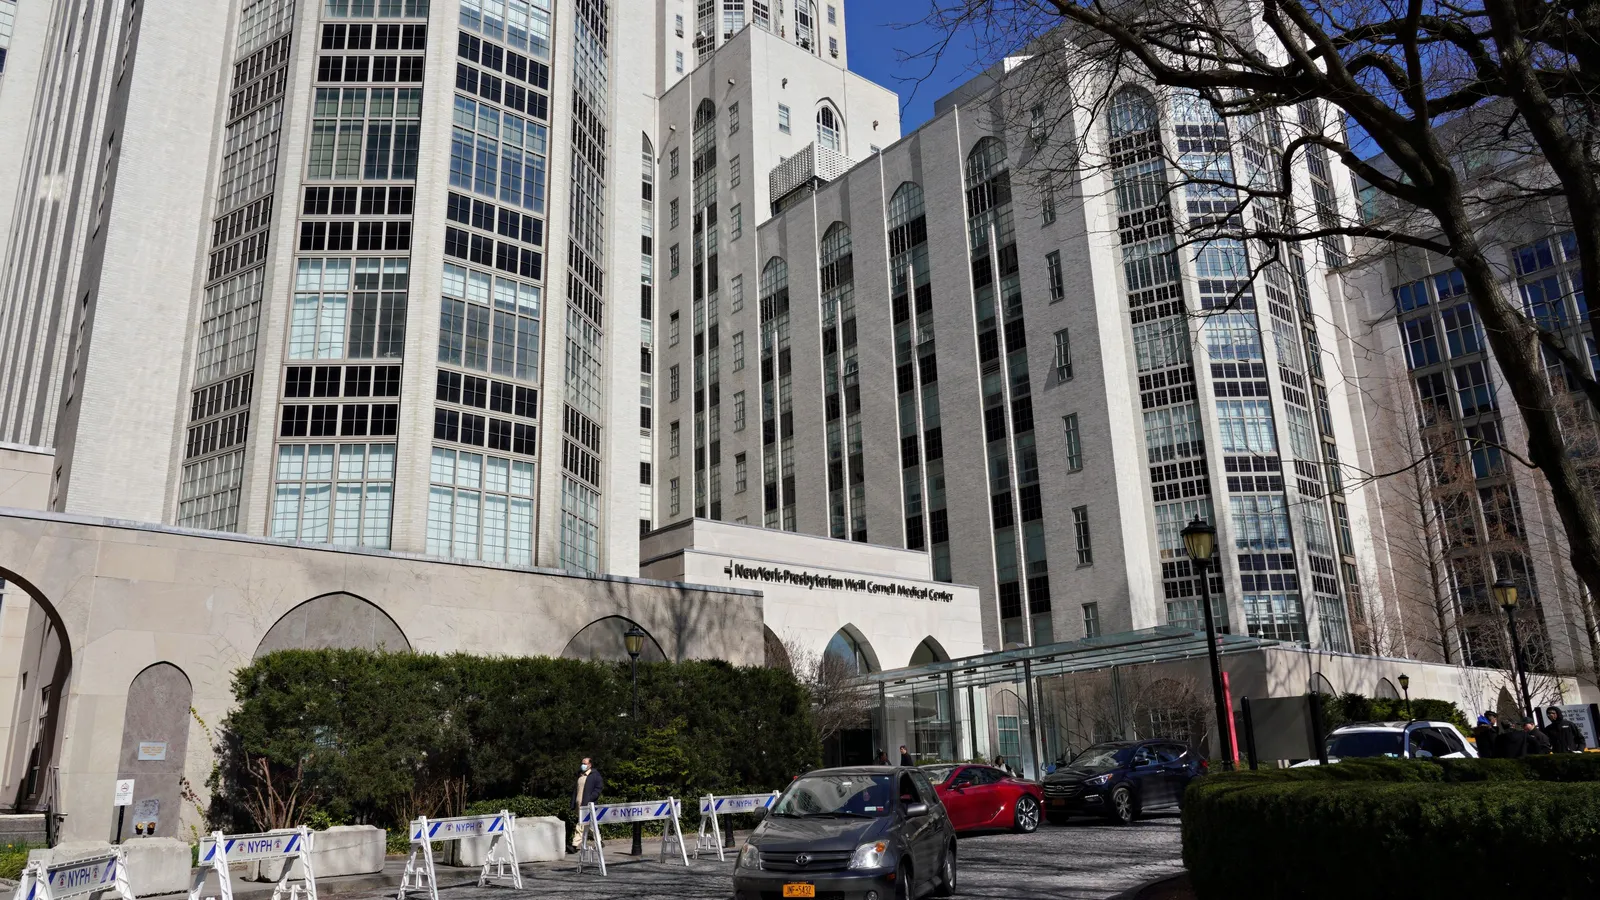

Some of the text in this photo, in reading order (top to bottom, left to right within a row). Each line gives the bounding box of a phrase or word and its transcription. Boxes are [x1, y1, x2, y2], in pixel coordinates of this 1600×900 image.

[844, 578, 866, 592] Weill
[867, 581, 896, 596] Cornell
[897, 584, 928, 600] Medical
[928, 588, 954, 603] Center
[735, 799, 752, 808] NYPH
[620, 806, 643, 818] NYPH
[456, 822, 475, 833] NYPH
[247, 839, 272, 854] NYPH
[67, 867, 91, 888] NYPH
